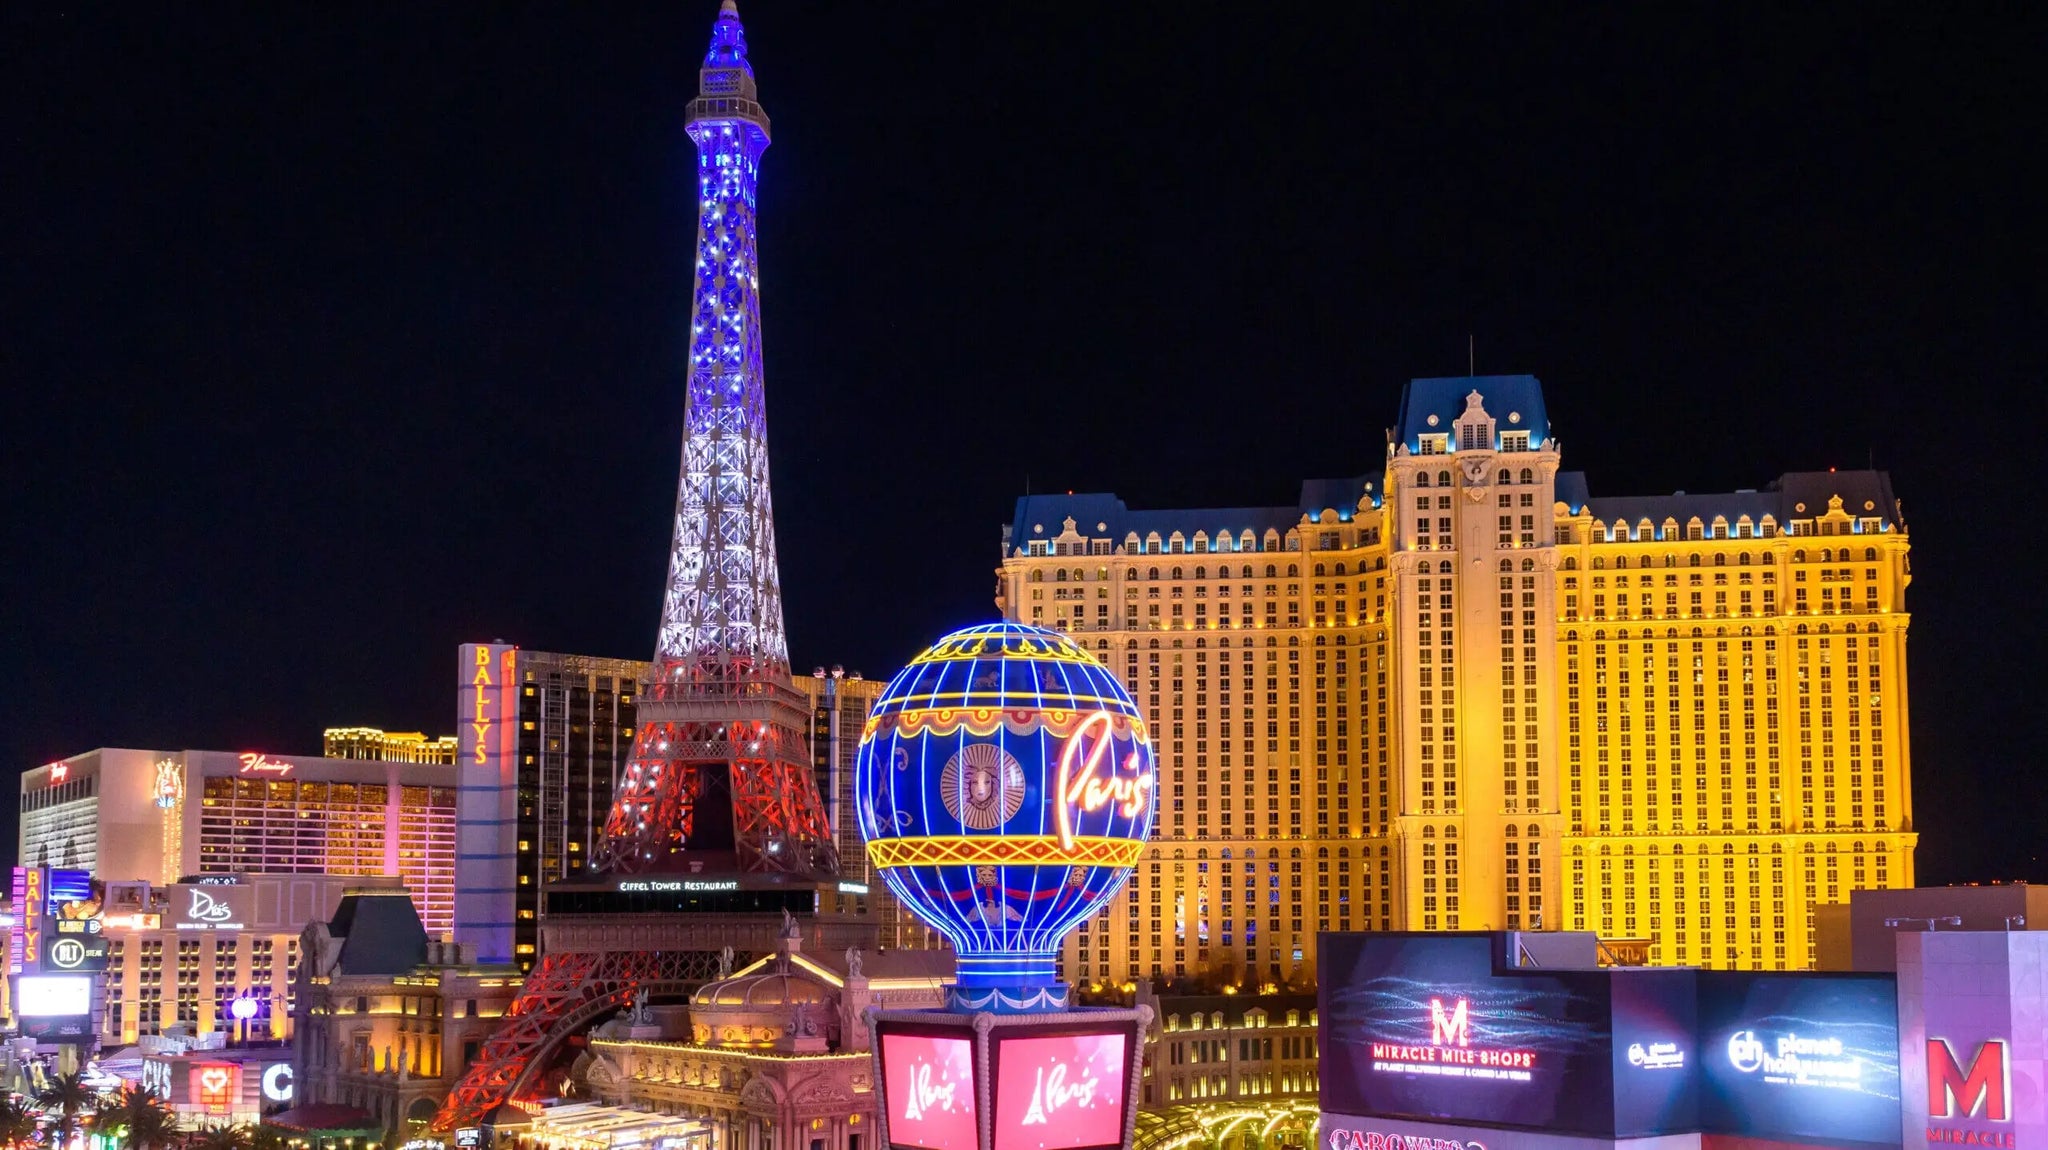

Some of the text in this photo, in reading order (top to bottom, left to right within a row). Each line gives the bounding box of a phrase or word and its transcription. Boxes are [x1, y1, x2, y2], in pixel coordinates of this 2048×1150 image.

[473, 646, 492, 764] BALLYS
[1057, 710, 1152, 850] Paris
[620, 881, 737, 891] EIFFEL TOWER RESTAURANT
[59, 944, 78, 962] BLT
[1432, 999, 1468, 1047] M
[1373, 1045, 1531, 1067] MIRACLE MILE SHOPS
[1777, 1033, 1842, 1058] planet
[143, 1059, 172, 1100] CVS
[262, 1063, 293, 1101] C
[917, 1063, 956, 1111] Paris
[1046, 1063, 1099, 1113] Paris
[1927, 1038, 2010, 1121] M
[1925, 1127, 2016, 1150] MIRACLE
